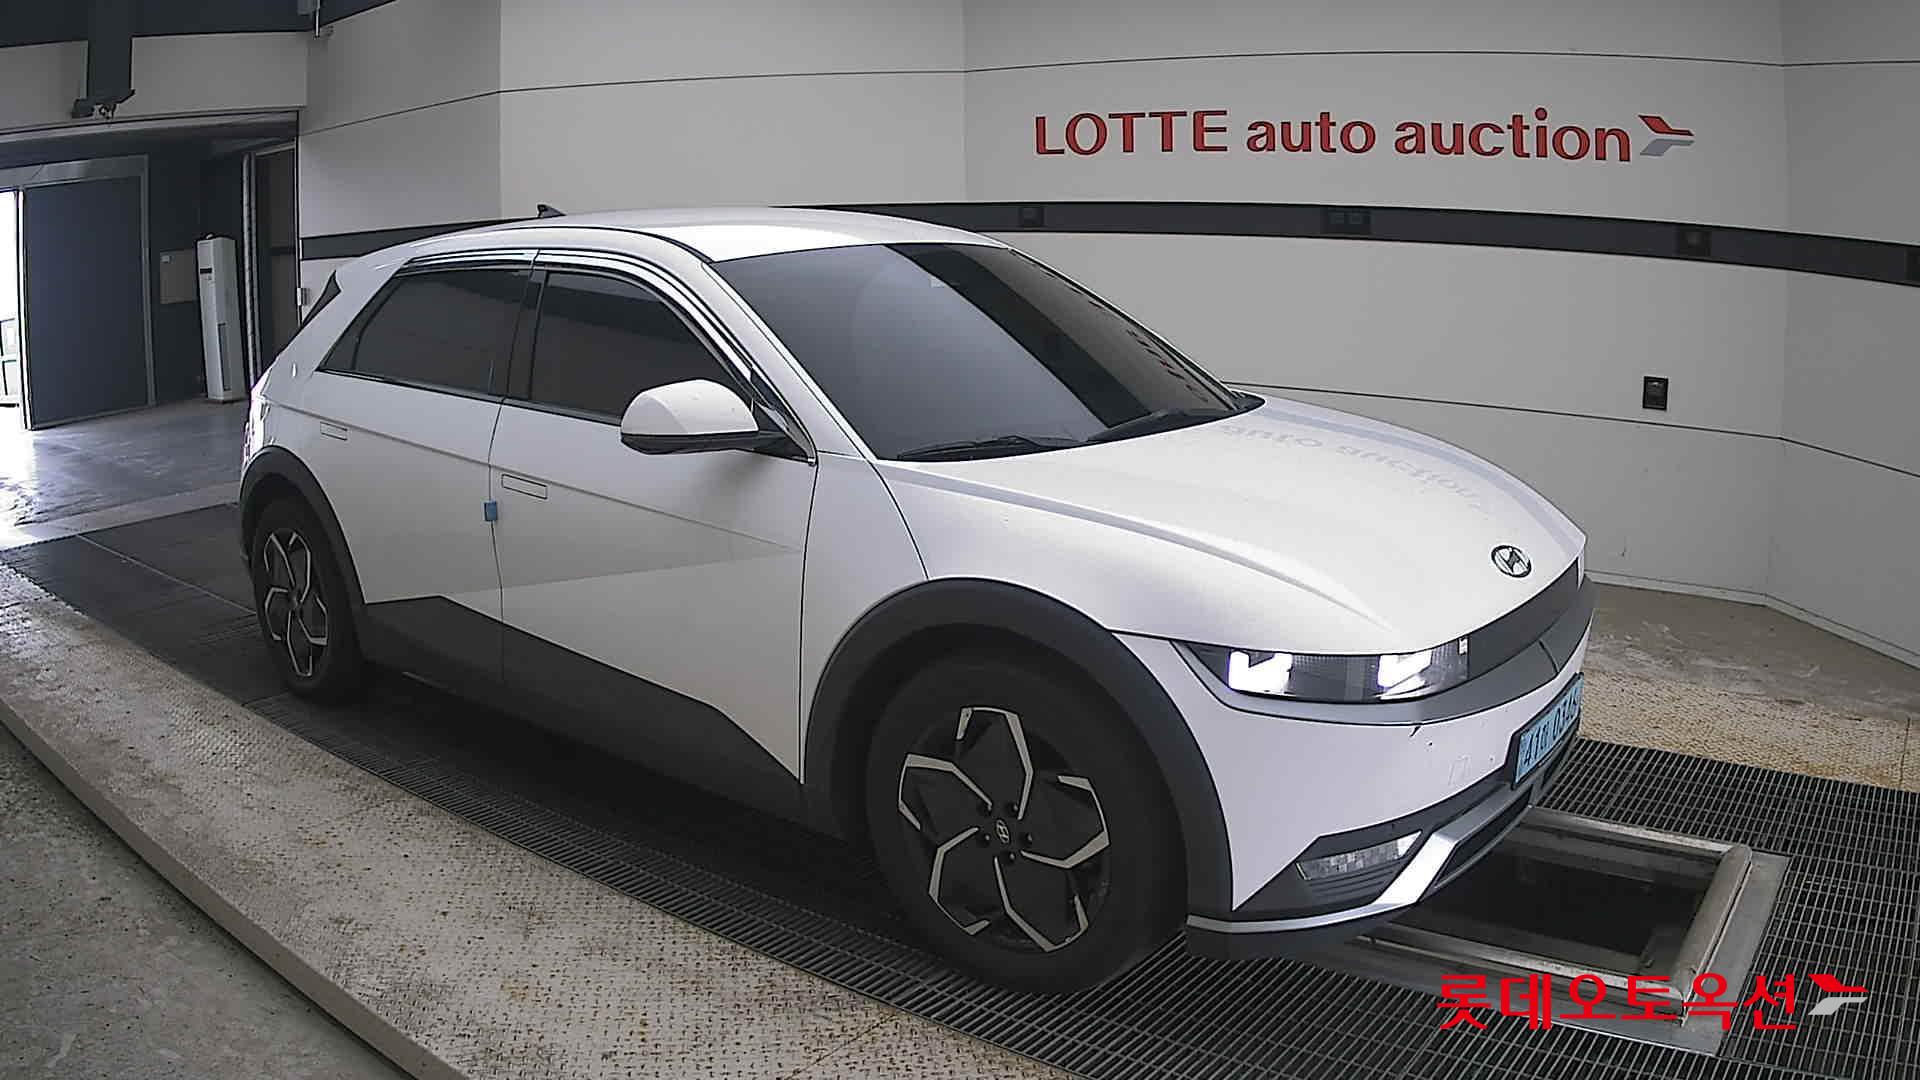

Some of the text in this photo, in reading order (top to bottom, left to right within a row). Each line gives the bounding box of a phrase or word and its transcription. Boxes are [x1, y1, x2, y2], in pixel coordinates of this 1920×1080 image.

[1035, 107, 1631, 162] LOTTE auto auction
